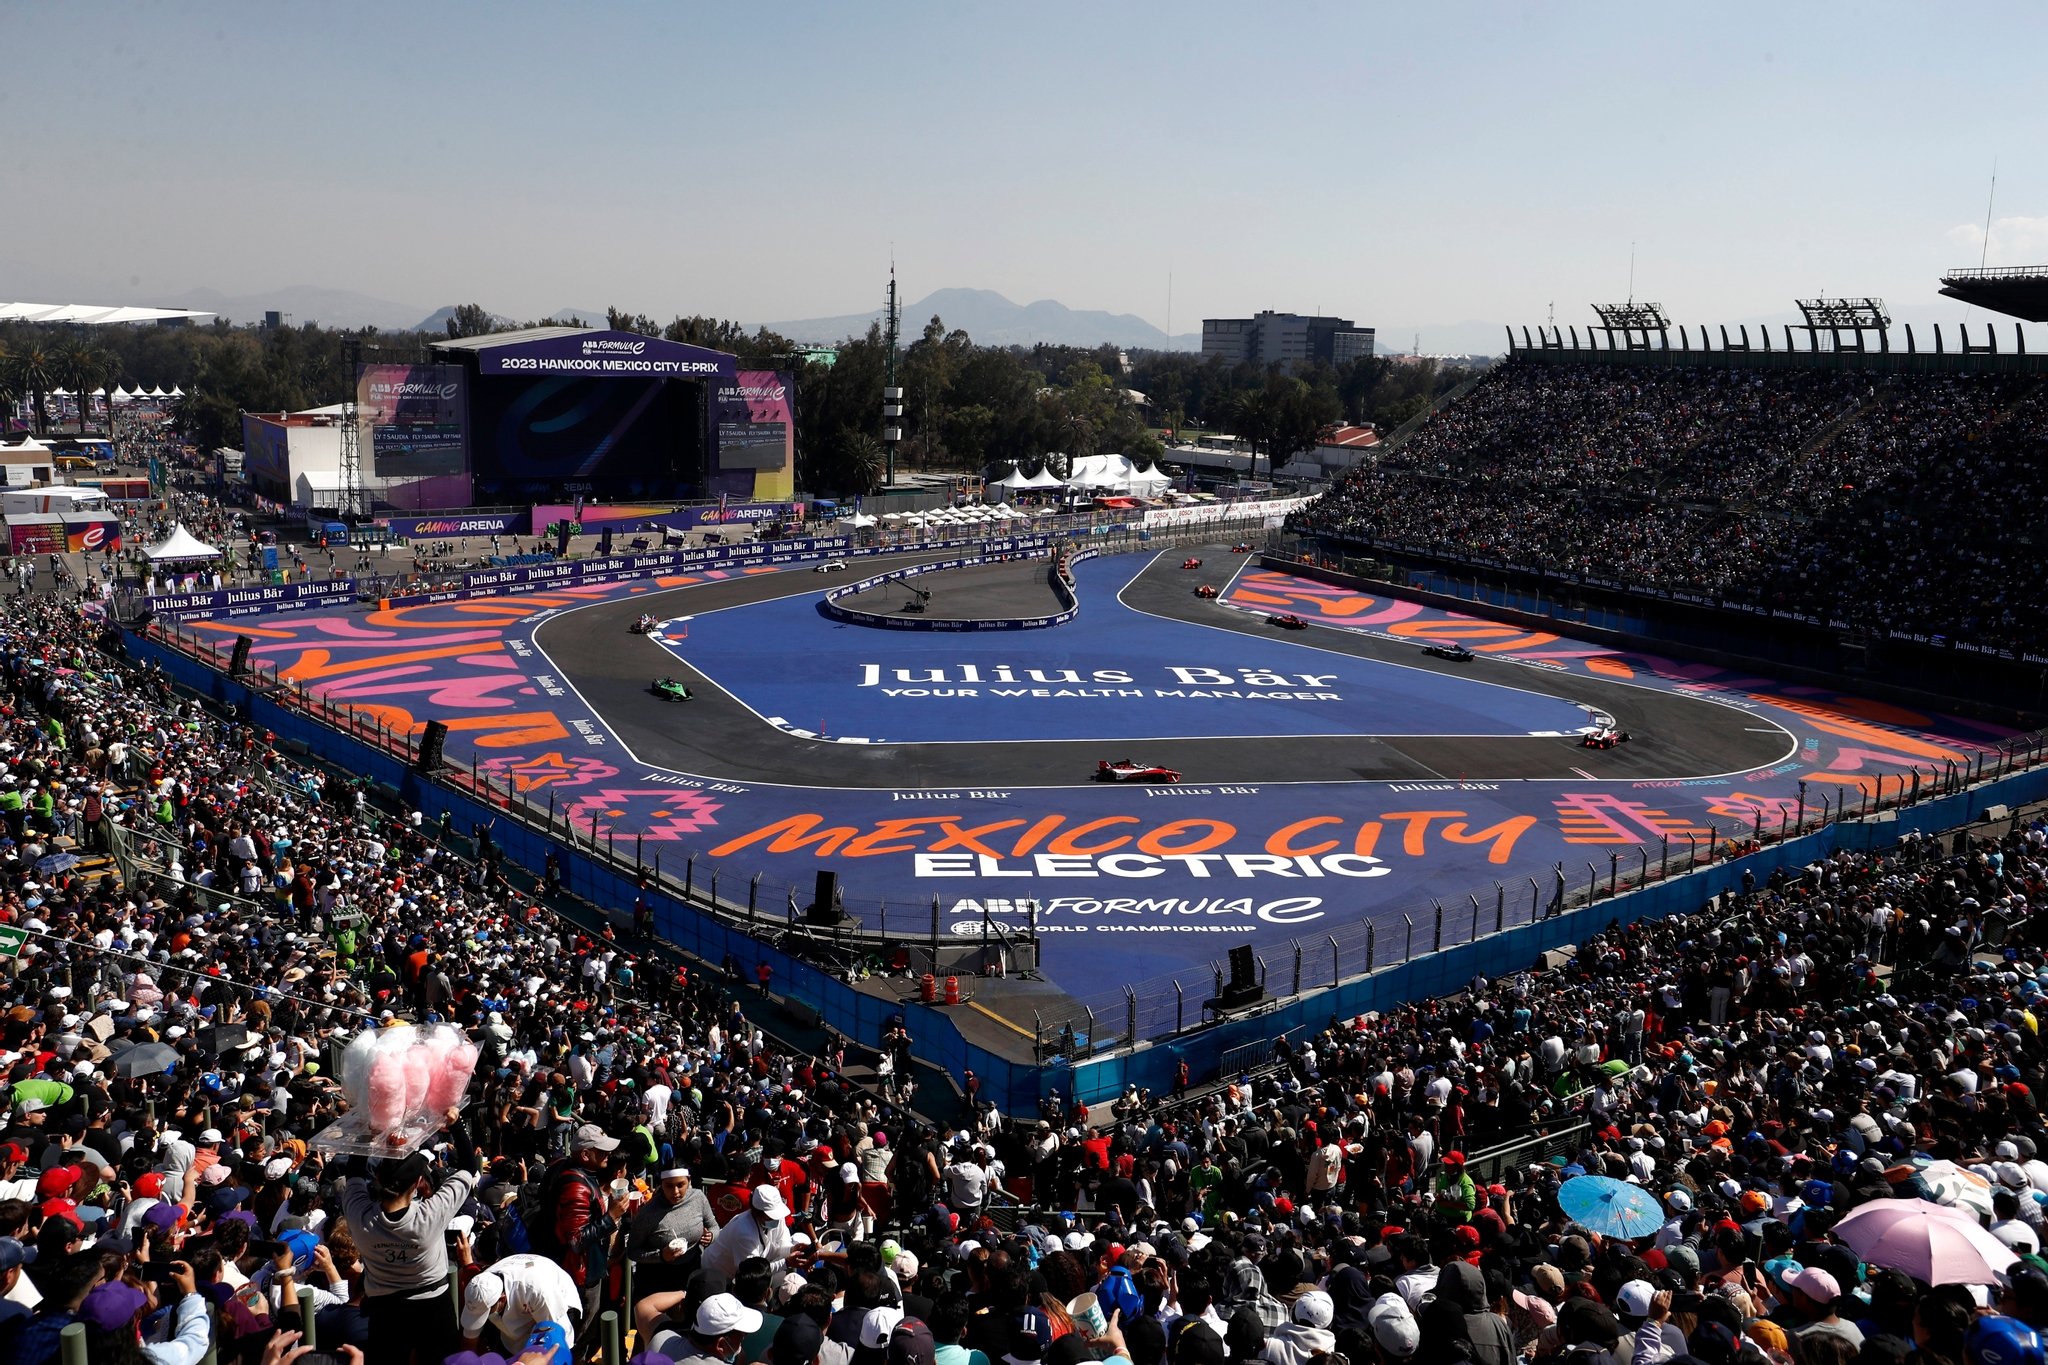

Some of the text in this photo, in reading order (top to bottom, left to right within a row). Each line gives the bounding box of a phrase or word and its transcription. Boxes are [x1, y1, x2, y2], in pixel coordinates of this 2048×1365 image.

[598, 341, 633, 350] FORMULA
[502, 358, 719, 372] 2023 HANKOOK MEXICO CITY E-PRIX
[370, 384, 390, 392] ABB
[773, 542, 806, 552] Julius Bär
[814, 541, 832, 549] Julius
[1019, 541, 1033, 549] Julius
[683, 550, 720, 562] Julius Bär
[729, 546, 764, 557] Julius Bär
[583, 561, 624, 574] Julius Bär
[634, 556, 674, 568] Julius Bär
[470, 572, 517, 587] Julius Bär
[528, 567, 572, 580] Julius Bär
[298, 585, 328, 597] Julius
[331, 581, 350, 592] Bär
[547, 580, 561, 588] Julius
[228, 589, 284, 604] Julius Bär
[430, 594, 446, 602] Julius
[1673, 592, 1690, 600] Julius
[153, 595, 213, 612] Julius Bär
[276, 602, 294, 610] Julius
[1723, 601, 1740, 610] Julius
[1742, 604, 1754, 612] Bär
[180, 612, 200, 621] Julius
[229, 607, 248, 616] Julius
[1773, 610, 1792, 618] Julius
[1794, 613, 1806, 621] Bär
[1890, 630, 1911, 640] Julius
[1914, 634, 1929, 642] Bär
[1955, 641, 1979, 652] Julius
[1981, 646, 1997, 654] Bär
[2023, 653, 2048, 664] Julius
[857, 663, 1338, 688] Julius Bär
[881, 688, 1344, 701] YOUR WEALTH MANAGER
[568, 719, 594, 735] Julius
[640, 773, 750, 793] Julius Bär
[1388, 783, 1500, 793] Julius Bär
[892, 790, 1012, 801] Julius Bär
[1144, 787, 1260, 798] Julius Bär
[708, 810, 1538, 864] MEXICO CITY
[914, 853, 1392, 878] ELECTRIC
[950, 898, 1042, 912] ABB
[1045, 897, 1253, 915] FORMULA
[385, 1249, 408, 1263] 34
